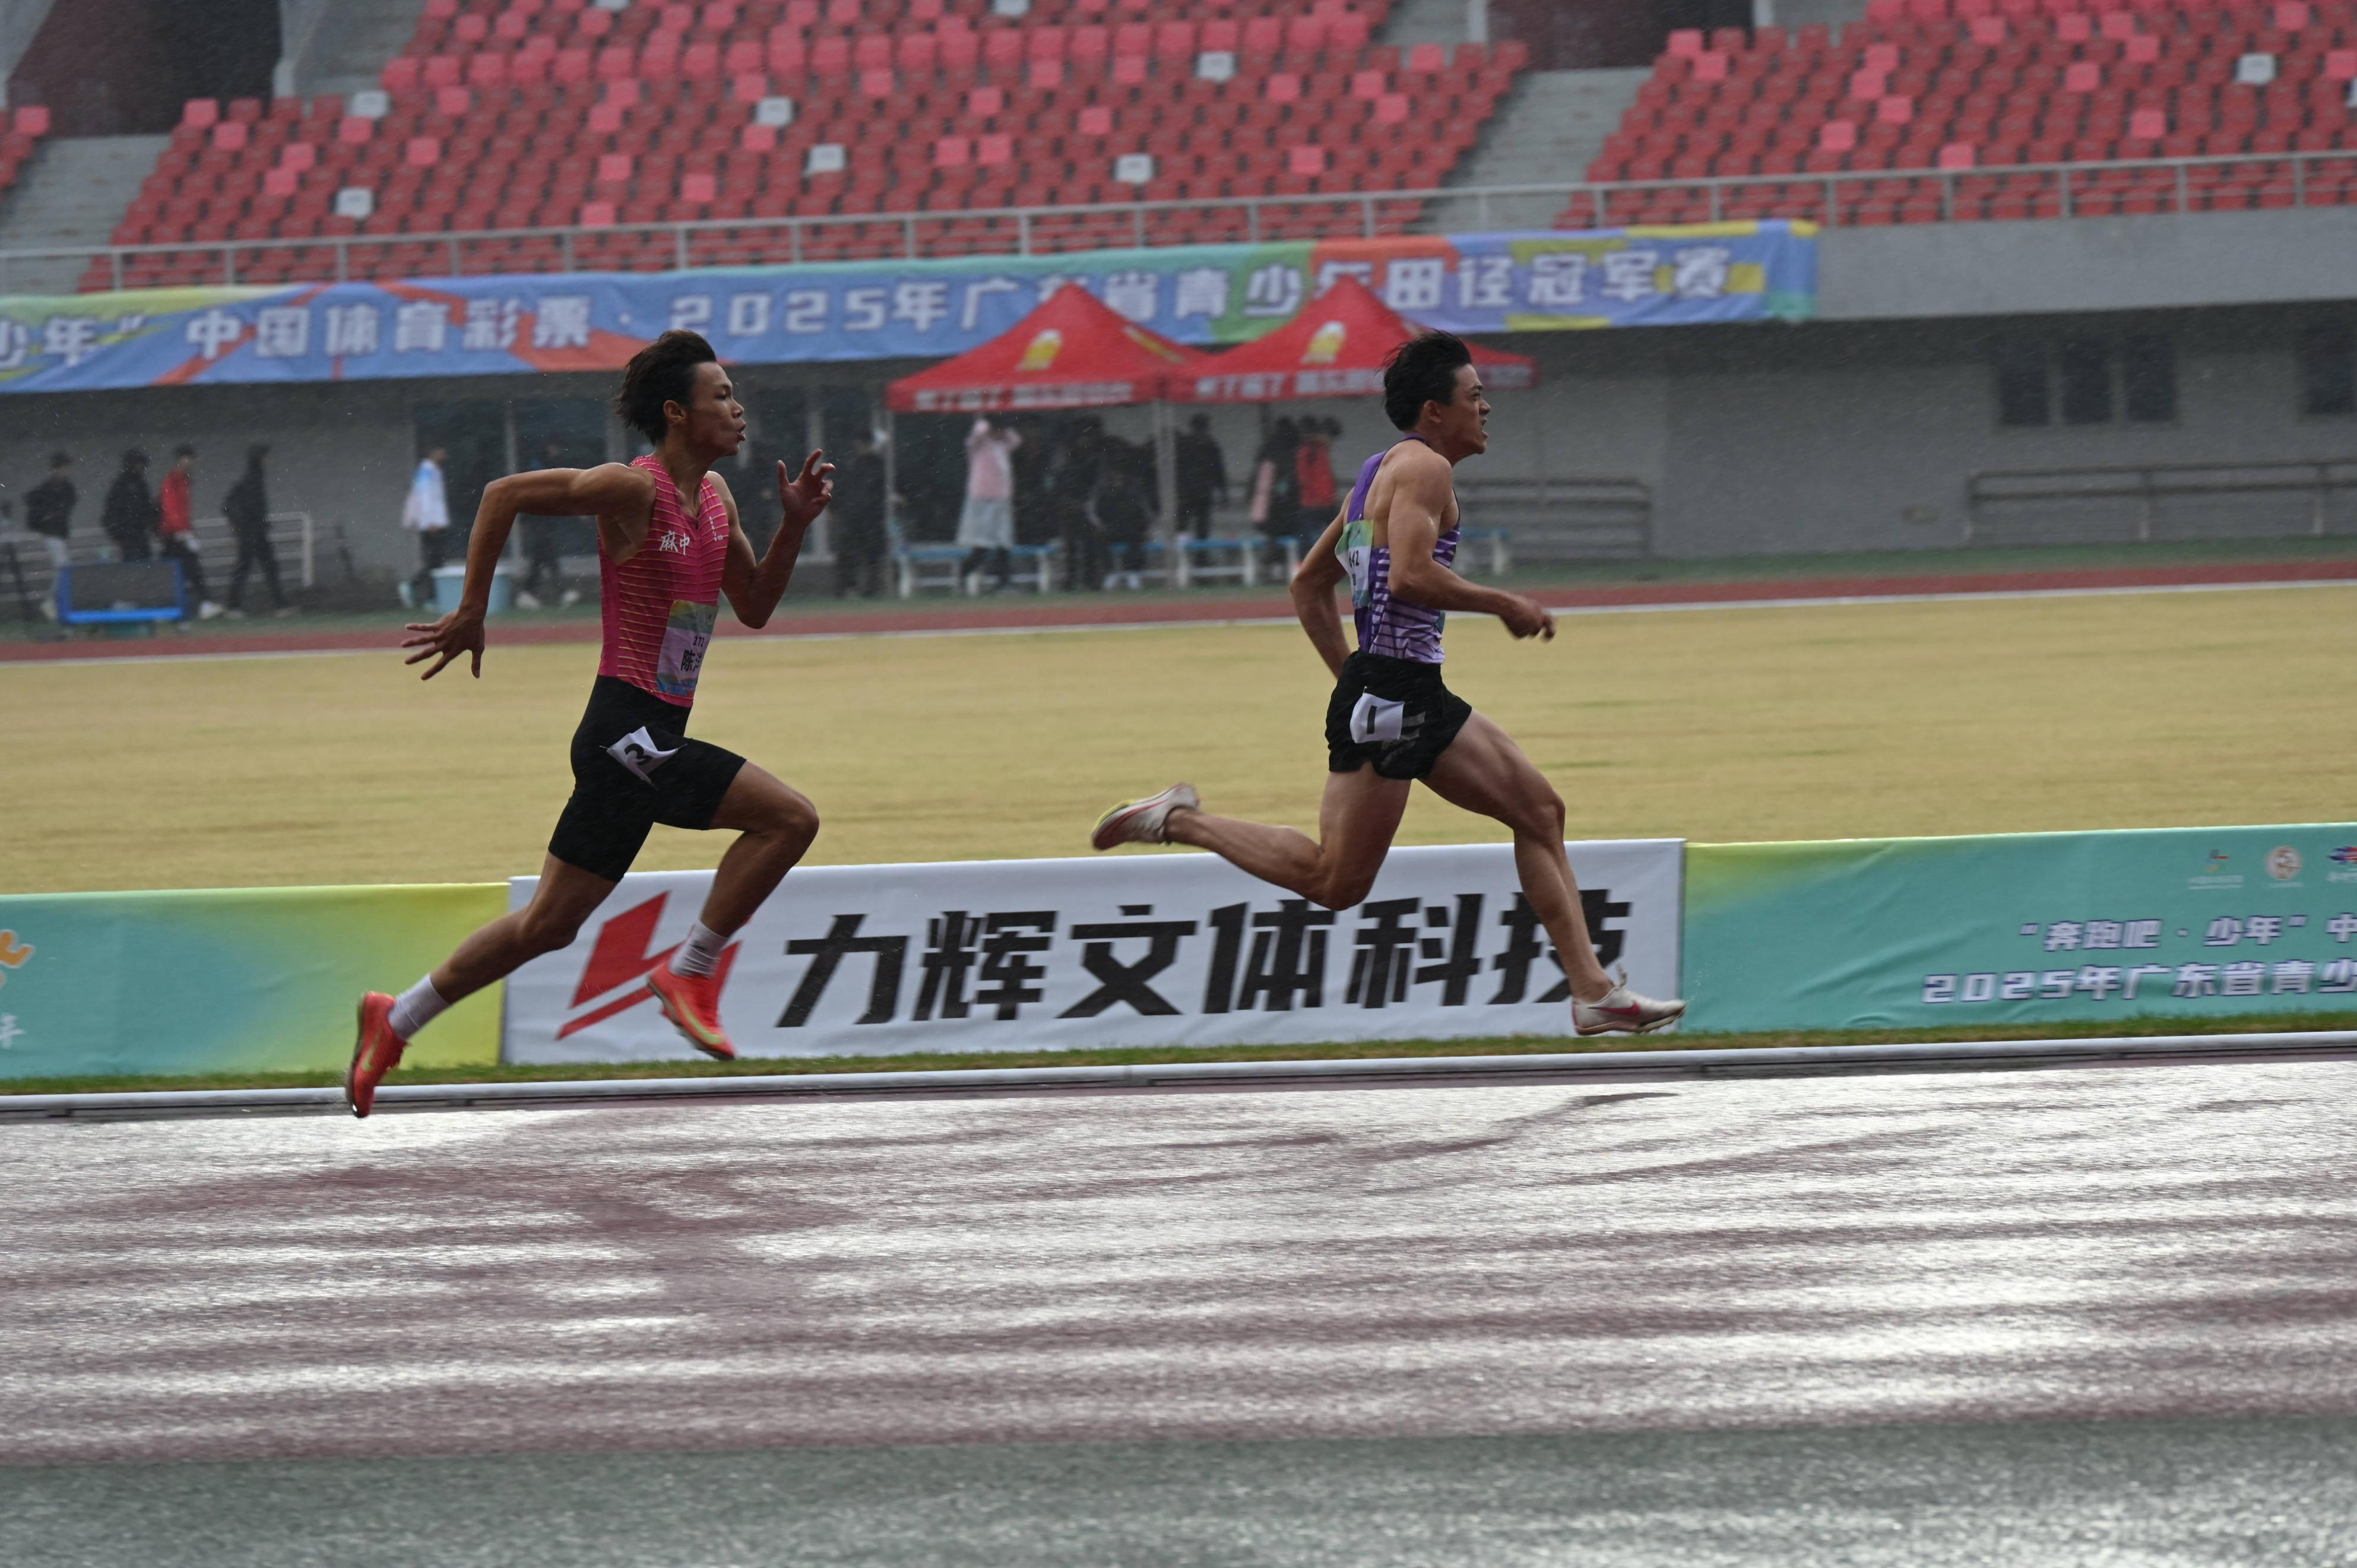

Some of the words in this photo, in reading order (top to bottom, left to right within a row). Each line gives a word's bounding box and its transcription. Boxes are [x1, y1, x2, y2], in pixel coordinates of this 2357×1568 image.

[659, 530, 690, 556] 麻中
[1367, 705, 1377, 734] 1
[775, 888, 1633, 1029] 力辉文体科技
[1921, 957, 2357, 1005] 2025年广东省青少
